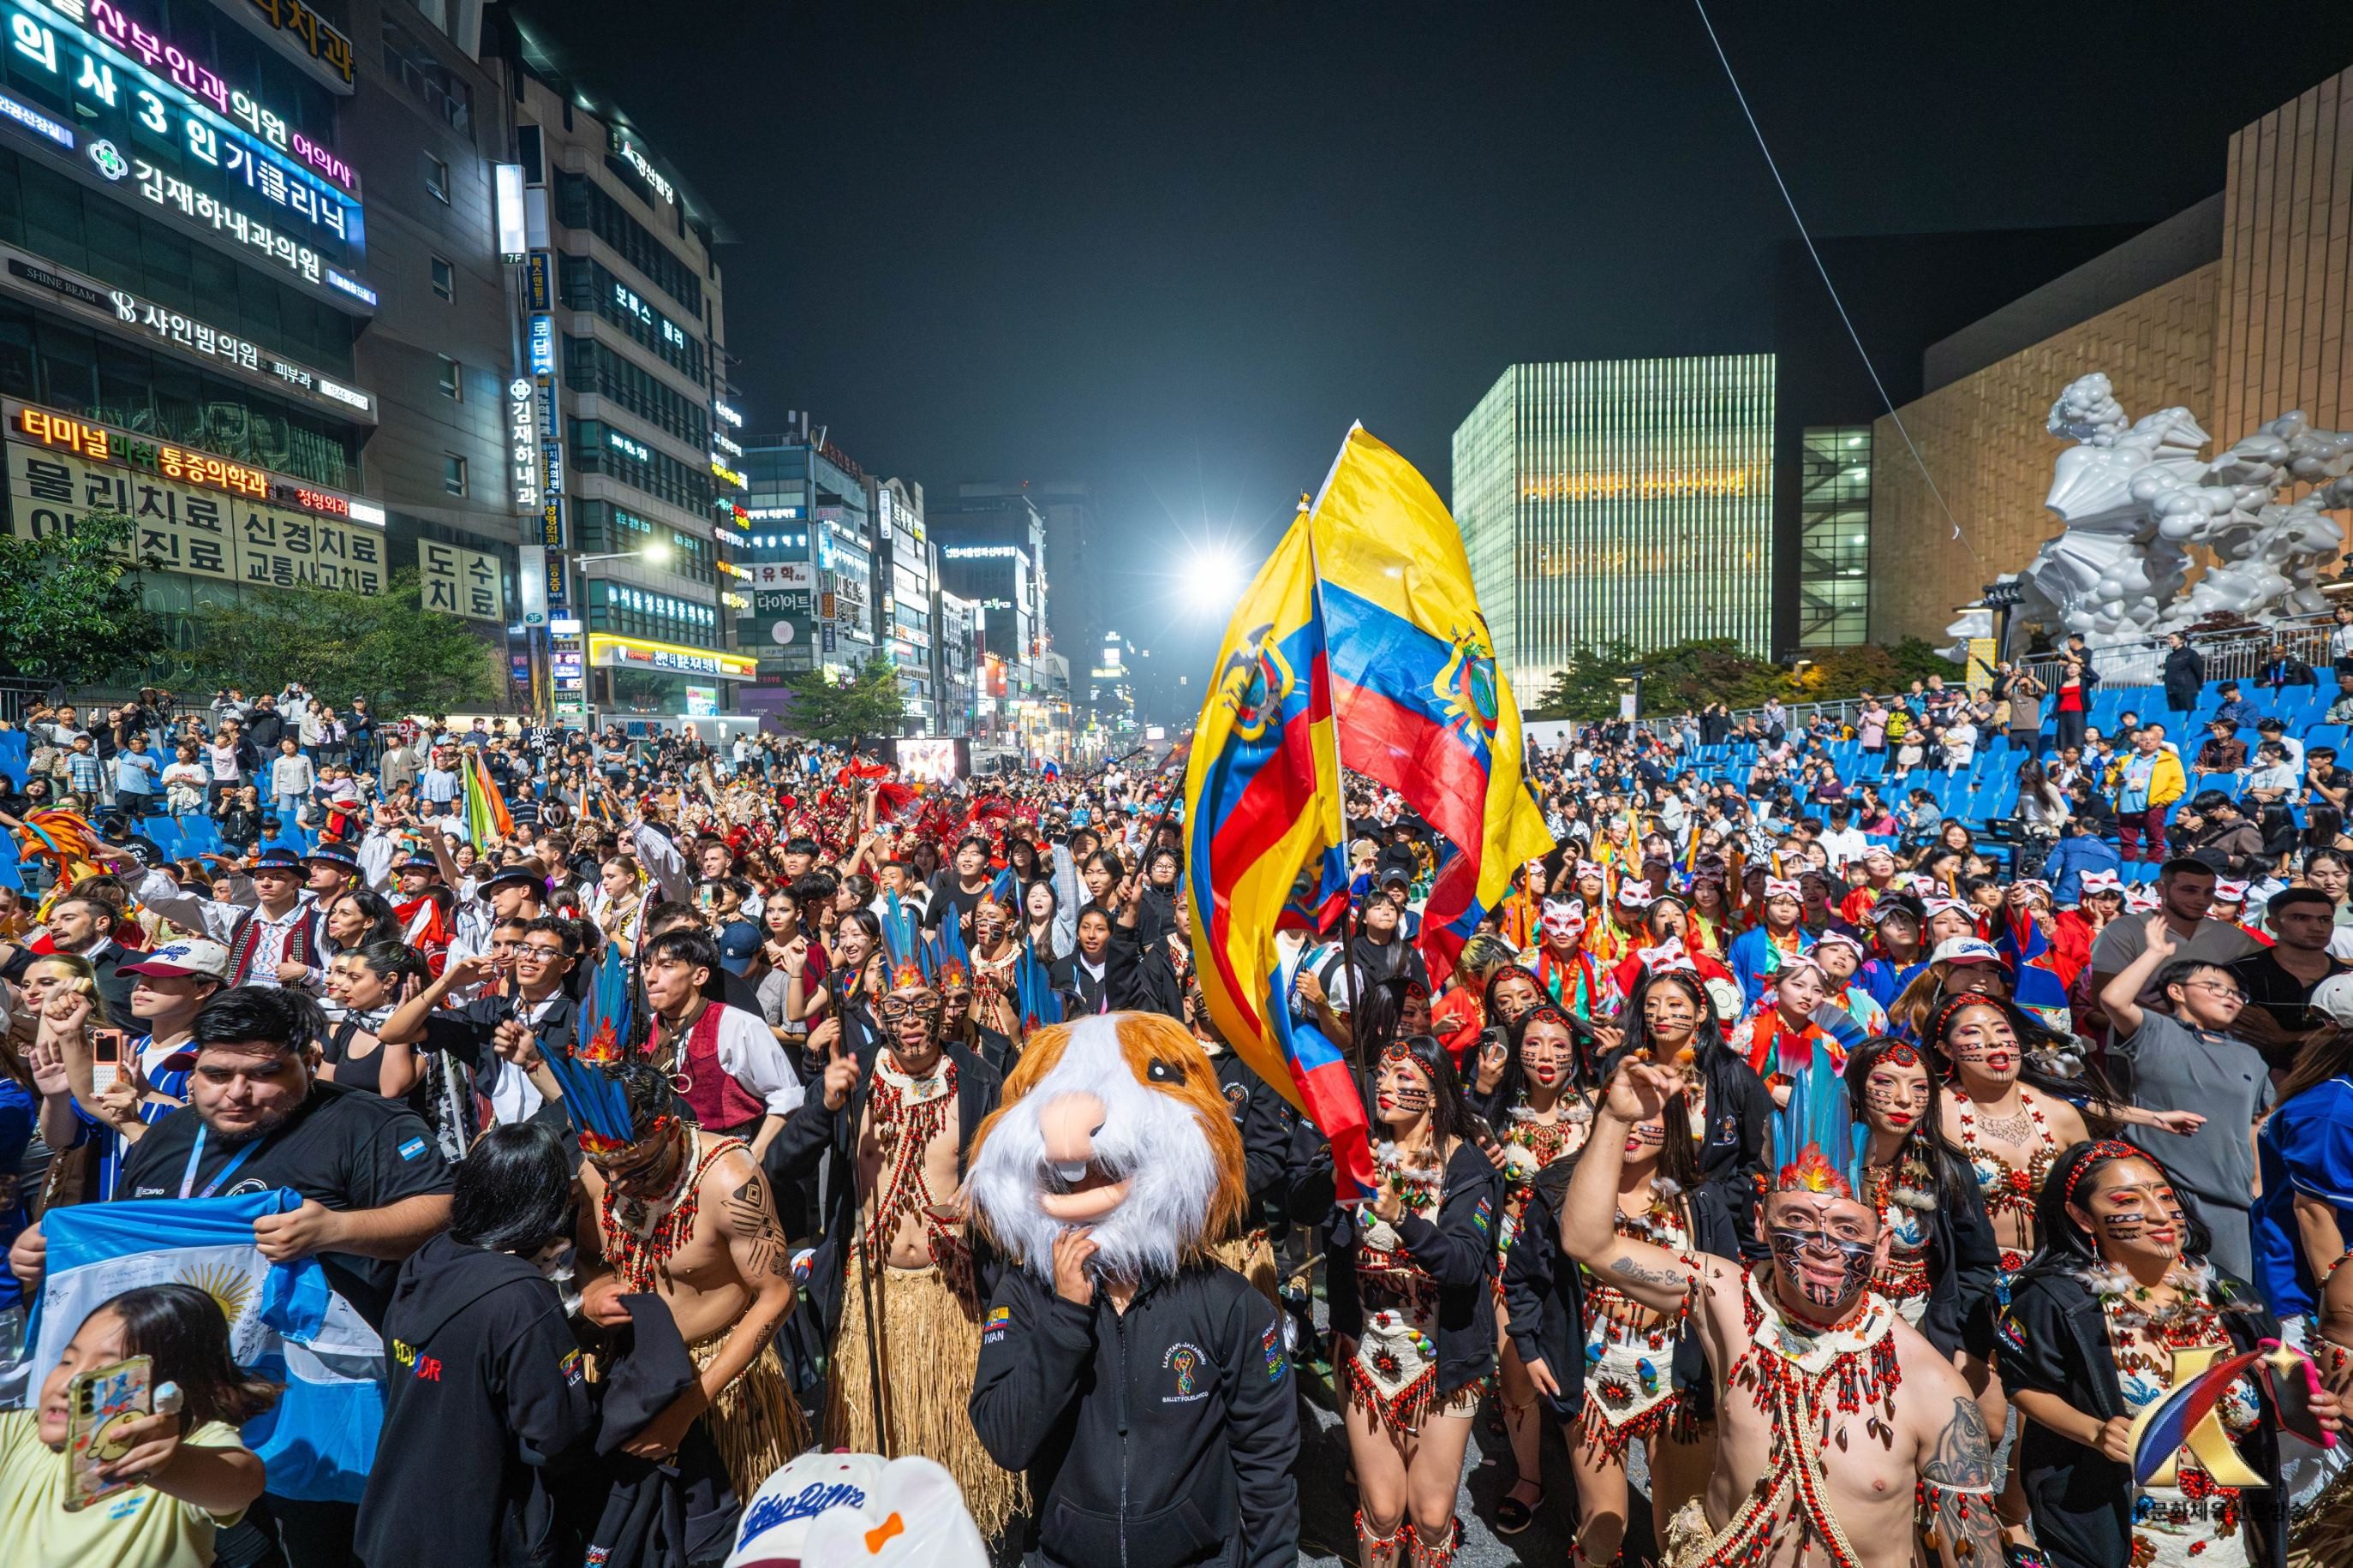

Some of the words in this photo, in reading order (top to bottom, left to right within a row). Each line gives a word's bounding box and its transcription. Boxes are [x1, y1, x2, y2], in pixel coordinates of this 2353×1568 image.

[292, 132, 352, 188] 여의사
[134, 159, 320, 285] 김재하내과의원
[507, 253, 522, 263] 7F
[27, 267, 63, 291] SHINE
[65, 281, 97, 303] BEAM
[616, 283, 652, 326] 보톡스
[662, 319, 684, 349] 필러
[143, 305, 258, 372] 샤인빔의원
[273, 361, 313, 391] 피부과
[512, 401, 538, 507] 김재하내과
[25, 456, 224, 534] 물리치료
[297, 486, 350, 518] 정형외과
[242, 511, 379, 566] 신경치료
[545, 505, 559, 544] 성형외과
[246, 549, 379, 596] 교통사고치료
[427, 545, 495, 583] 도수
[548, 563, 560, 593] 통증
[428, 579, 496, 617] 치료
[620, 588, 714, 626] 서울성모통증의학과
[758, 593, 811, 611] 다이어트
[528, 614, 540, 623] 3F
[984, 1330, 1004, 1344] IVAN
